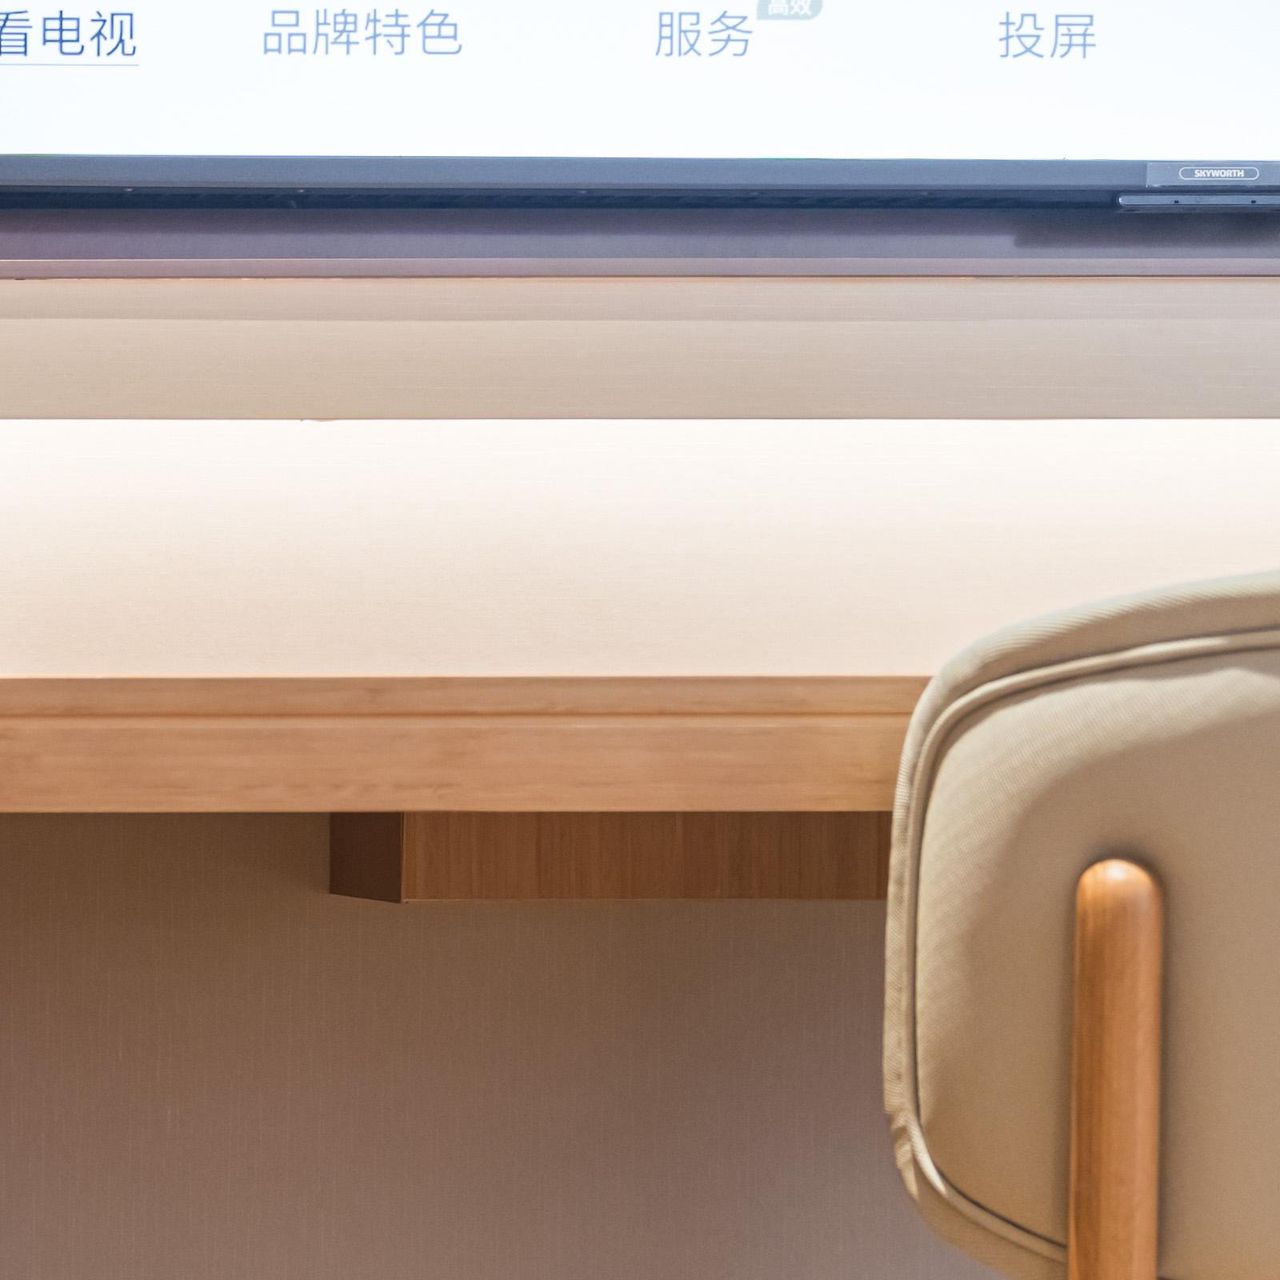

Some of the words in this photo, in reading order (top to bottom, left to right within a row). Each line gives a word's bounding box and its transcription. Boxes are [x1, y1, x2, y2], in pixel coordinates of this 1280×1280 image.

[262, 7, 463, 57] 品牌特色
[654, 10, 754, 58] 服务
[998, 11, 1098, 59] 投屏
[1193, 169, 1245, 178] SKYWORTH
